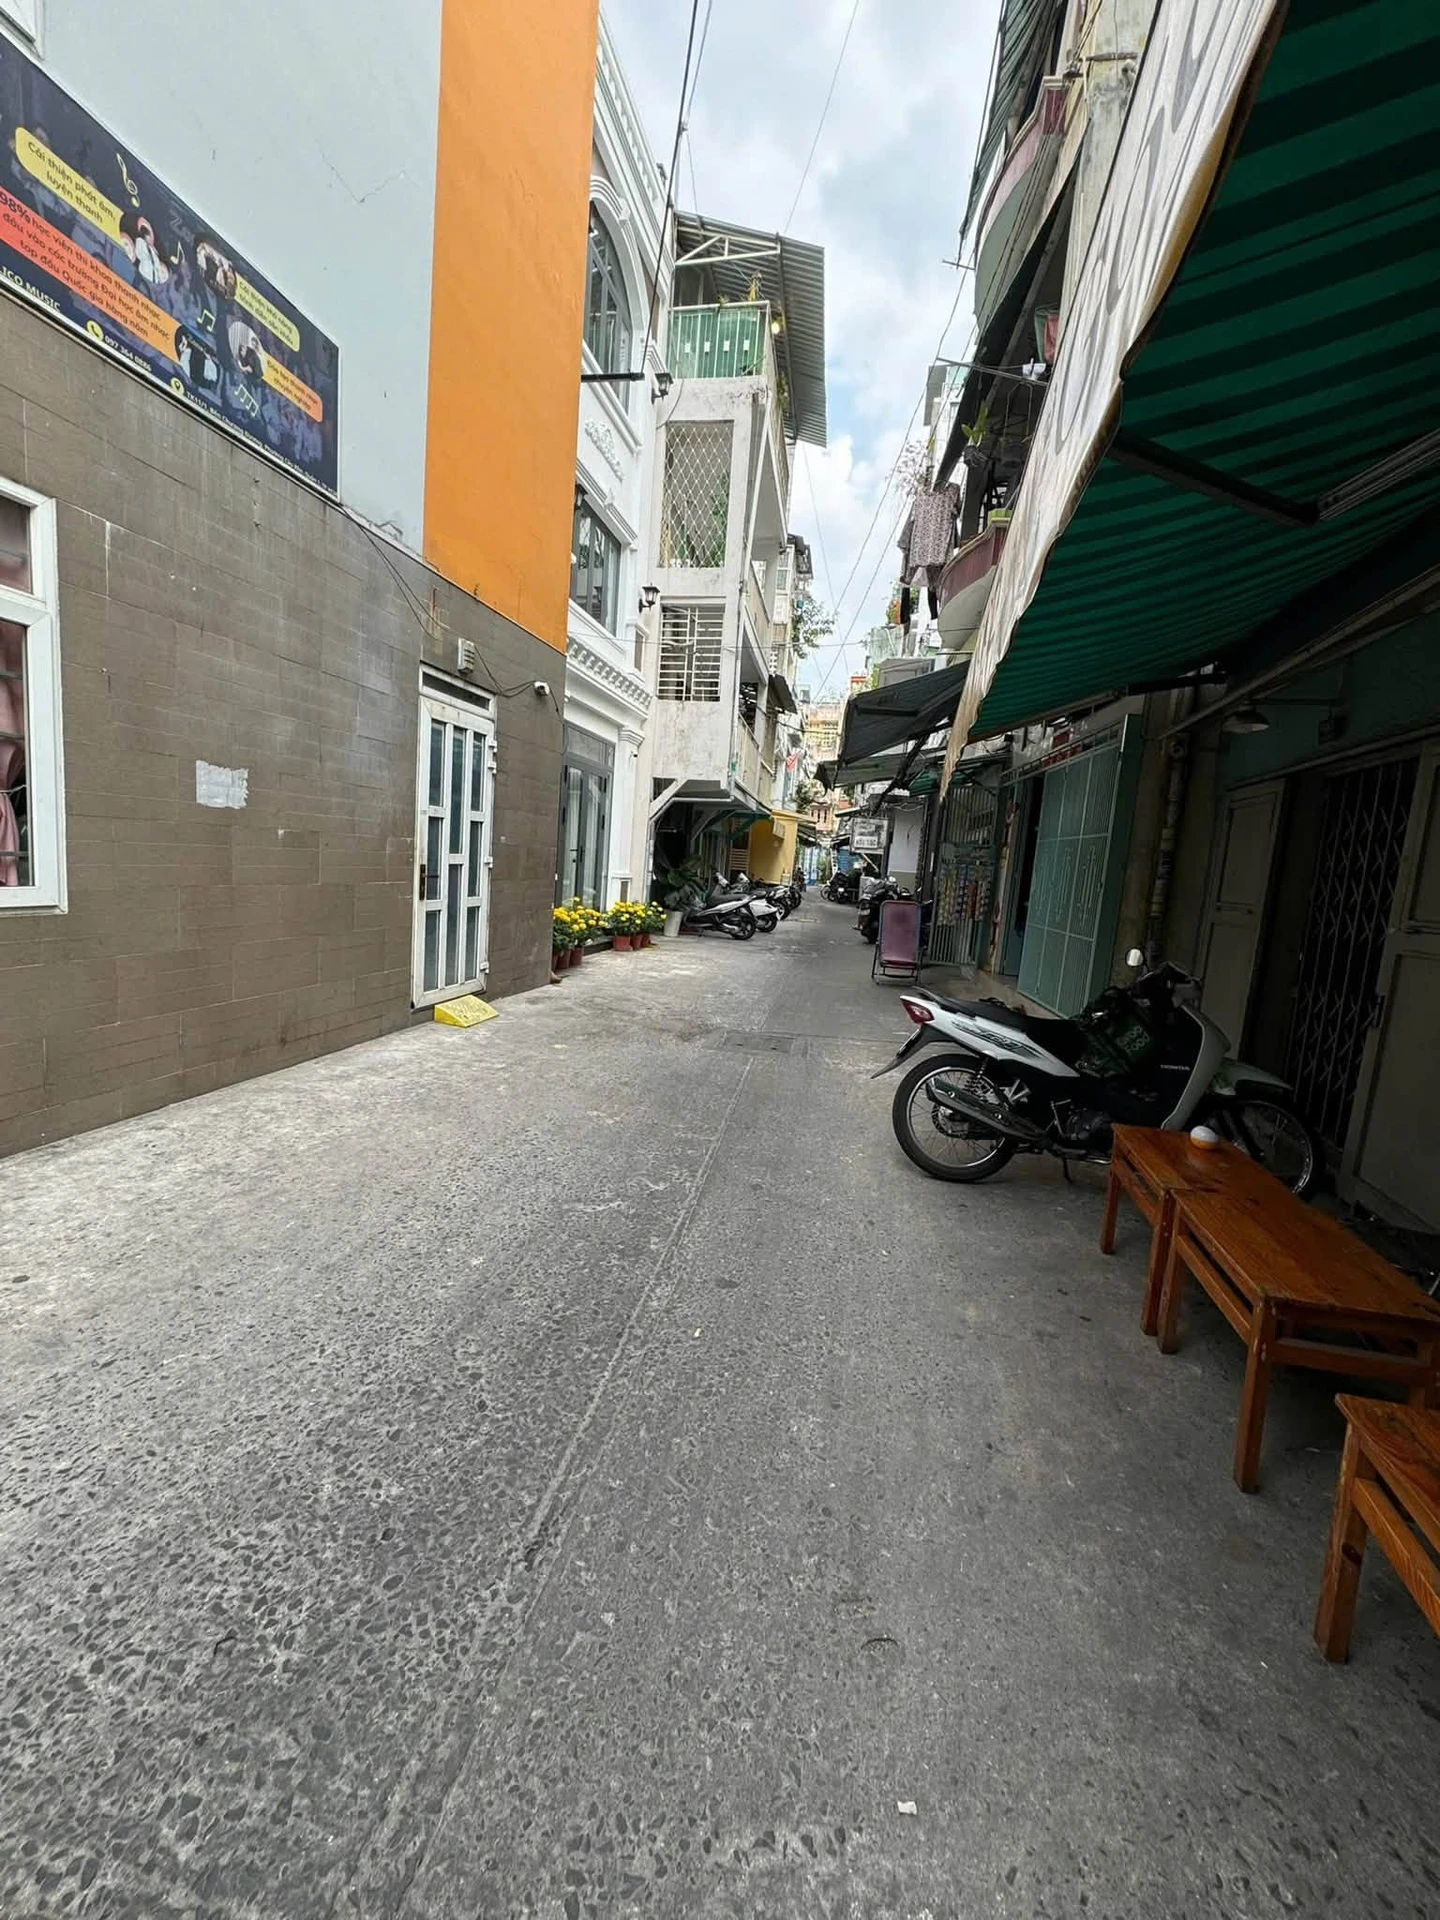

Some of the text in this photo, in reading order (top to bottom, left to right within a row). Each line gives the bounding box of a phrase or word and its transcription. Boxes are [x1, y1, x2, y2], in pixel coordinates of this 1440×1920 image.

[75, 194, 103, 222] thanh
[0, 191, 31, 223] 98%
[114, 280, 139, 304] thanh
[26, 282, 61, 312] MUSIC
